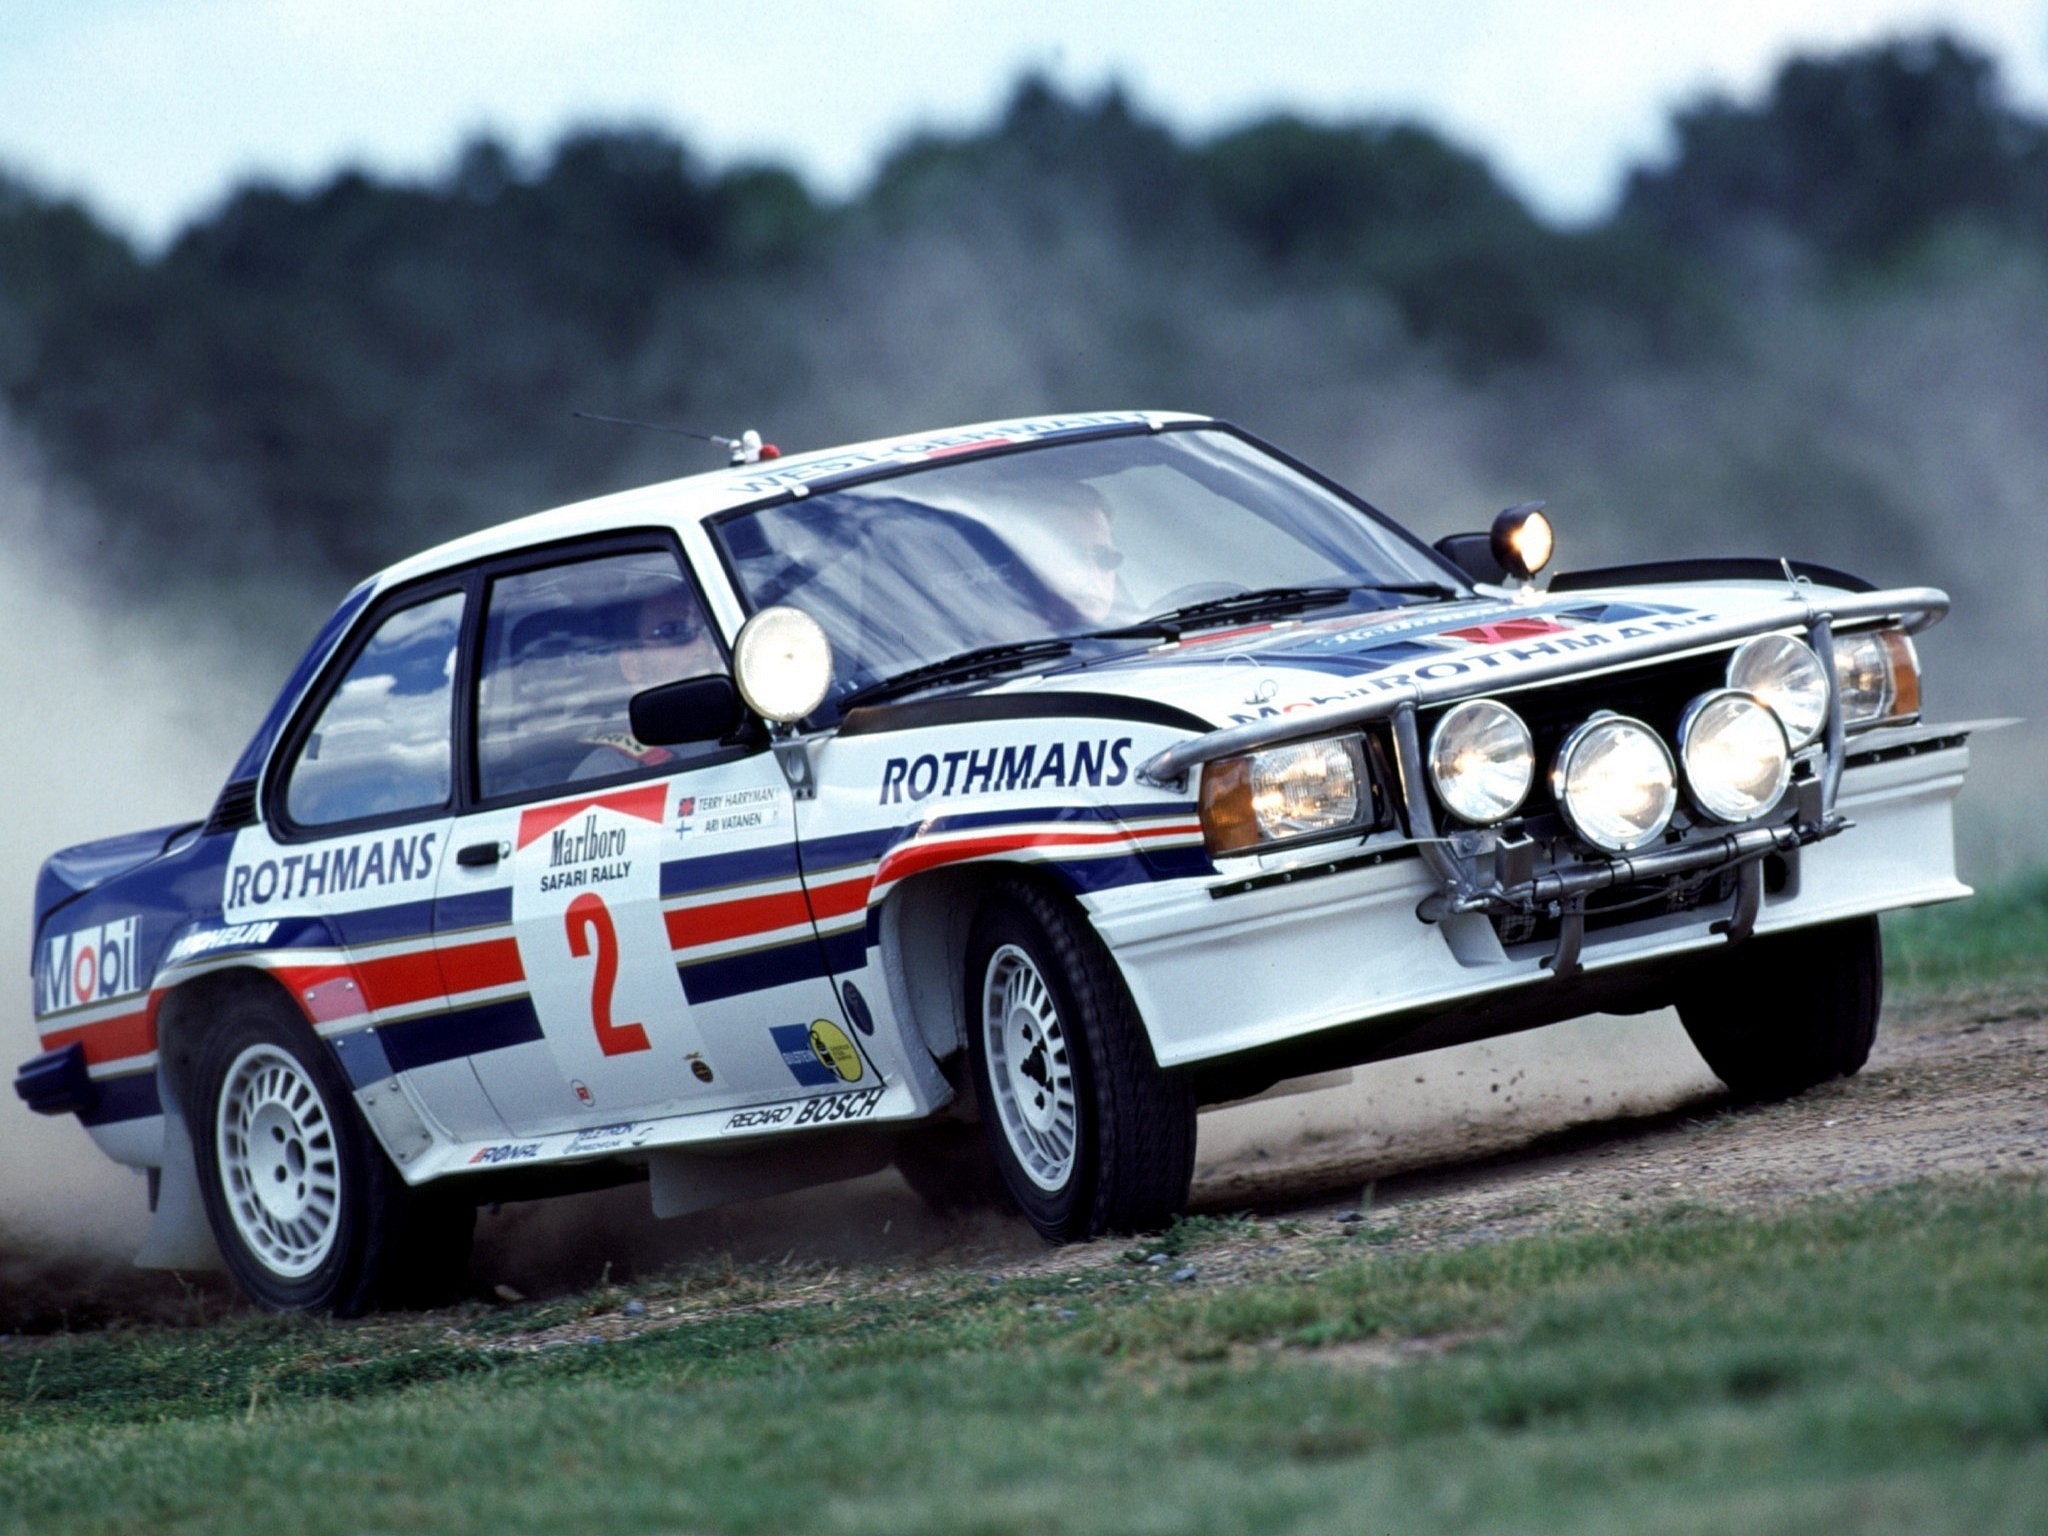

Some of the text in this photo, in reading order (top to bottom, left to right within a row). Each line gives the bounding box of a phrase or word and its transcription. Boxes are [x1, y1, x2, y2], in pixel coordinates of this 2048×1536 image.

[879, 737, 1132, 805] ROTHMANS
[699, 788, 774, 811] TERRY HARRYMAN
[704, 818, 719, 833] ARI
[721, 812, 761, 830] VATANEN
[549, 814, 626, 868] Marlboro
[227, 832, 436, 909] ROTHMANS
[540, 860, 632, 893] SAFARI RALLY
[40, 915, 142, 1014] Mobil
[565, 892, 652, 1057] 2
[725, 1089, 886, 1130] RECARO BOSCH
